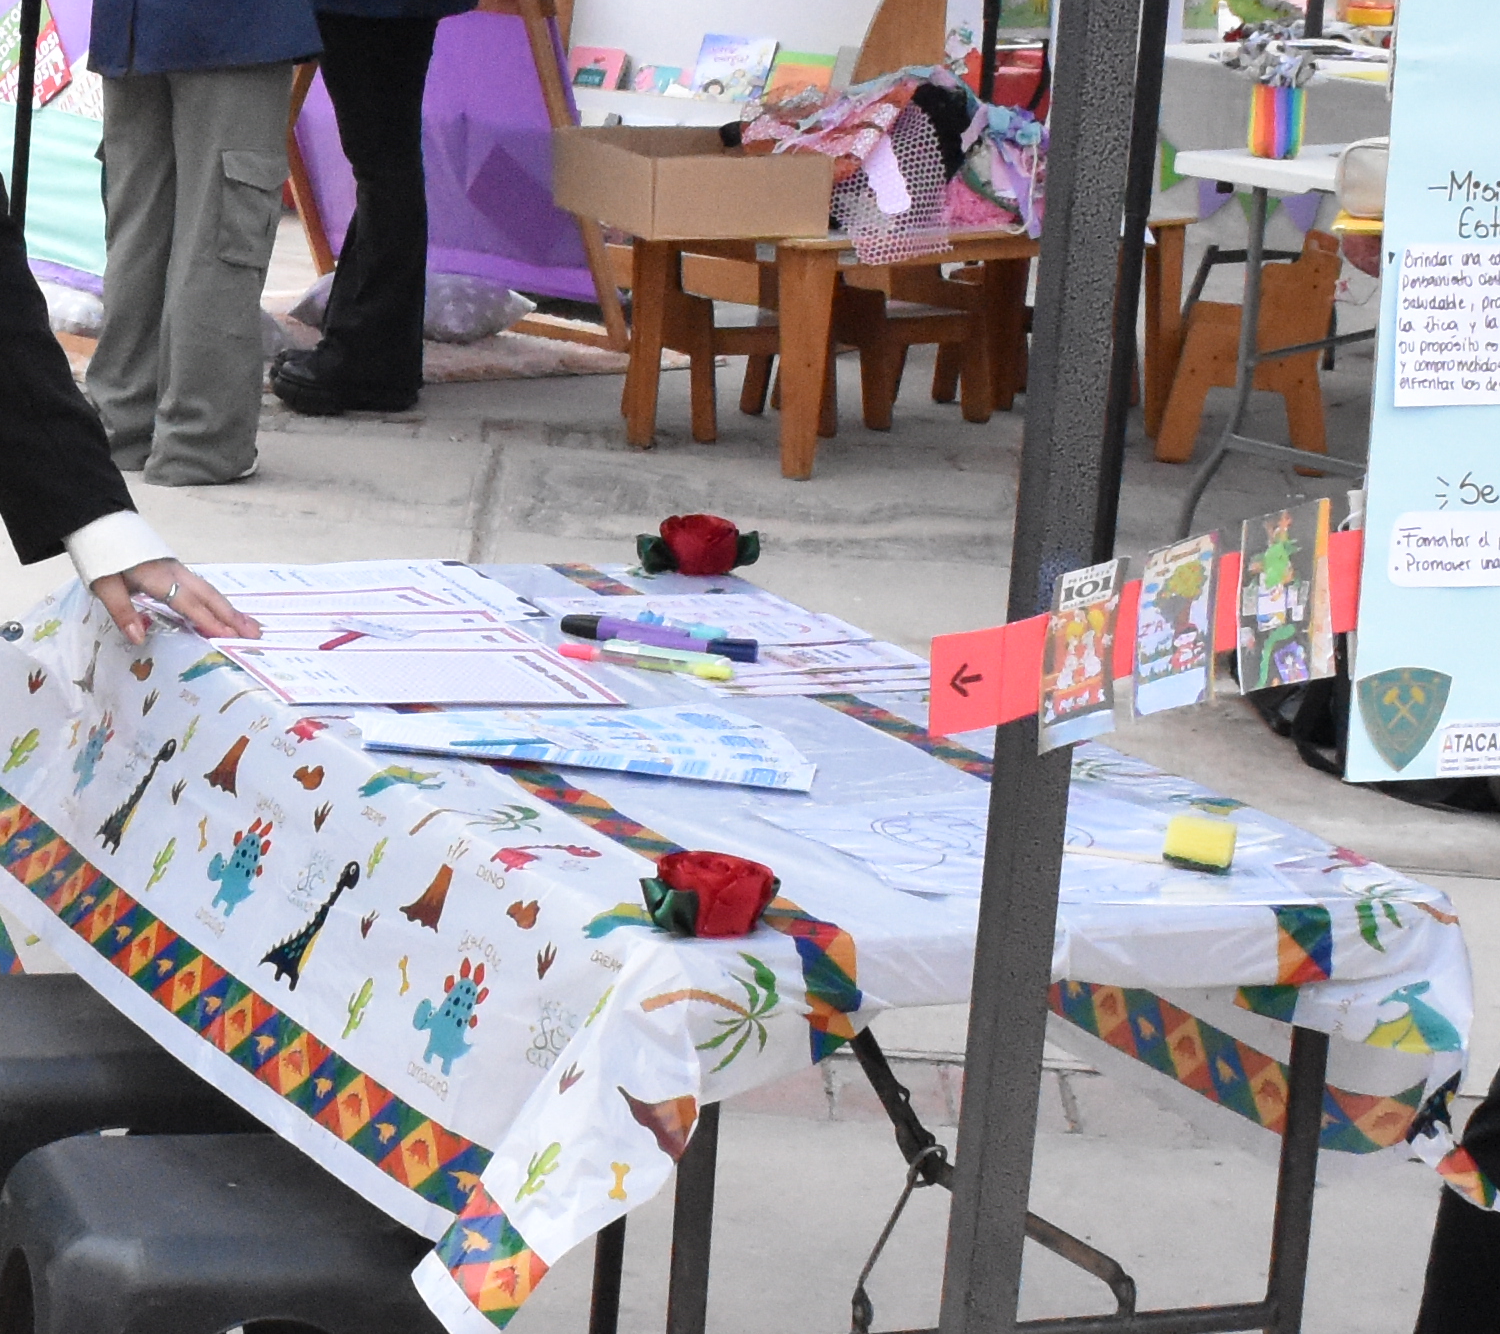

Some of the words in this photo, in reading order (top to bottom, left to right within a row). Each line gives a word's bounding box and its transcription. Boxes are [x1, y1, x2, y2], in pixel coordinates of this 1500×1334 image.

[1469, 322, 1476, 333] y
[1485, 316, 1499, 329] la
[1462, 378, 1480, 391] los
[1406, 553, 1471, 572] Promover
[1481, 558, 1500, 570] una
[1063, 575, 1114, 604] 101
[475, 864, 506, 890] DINO
